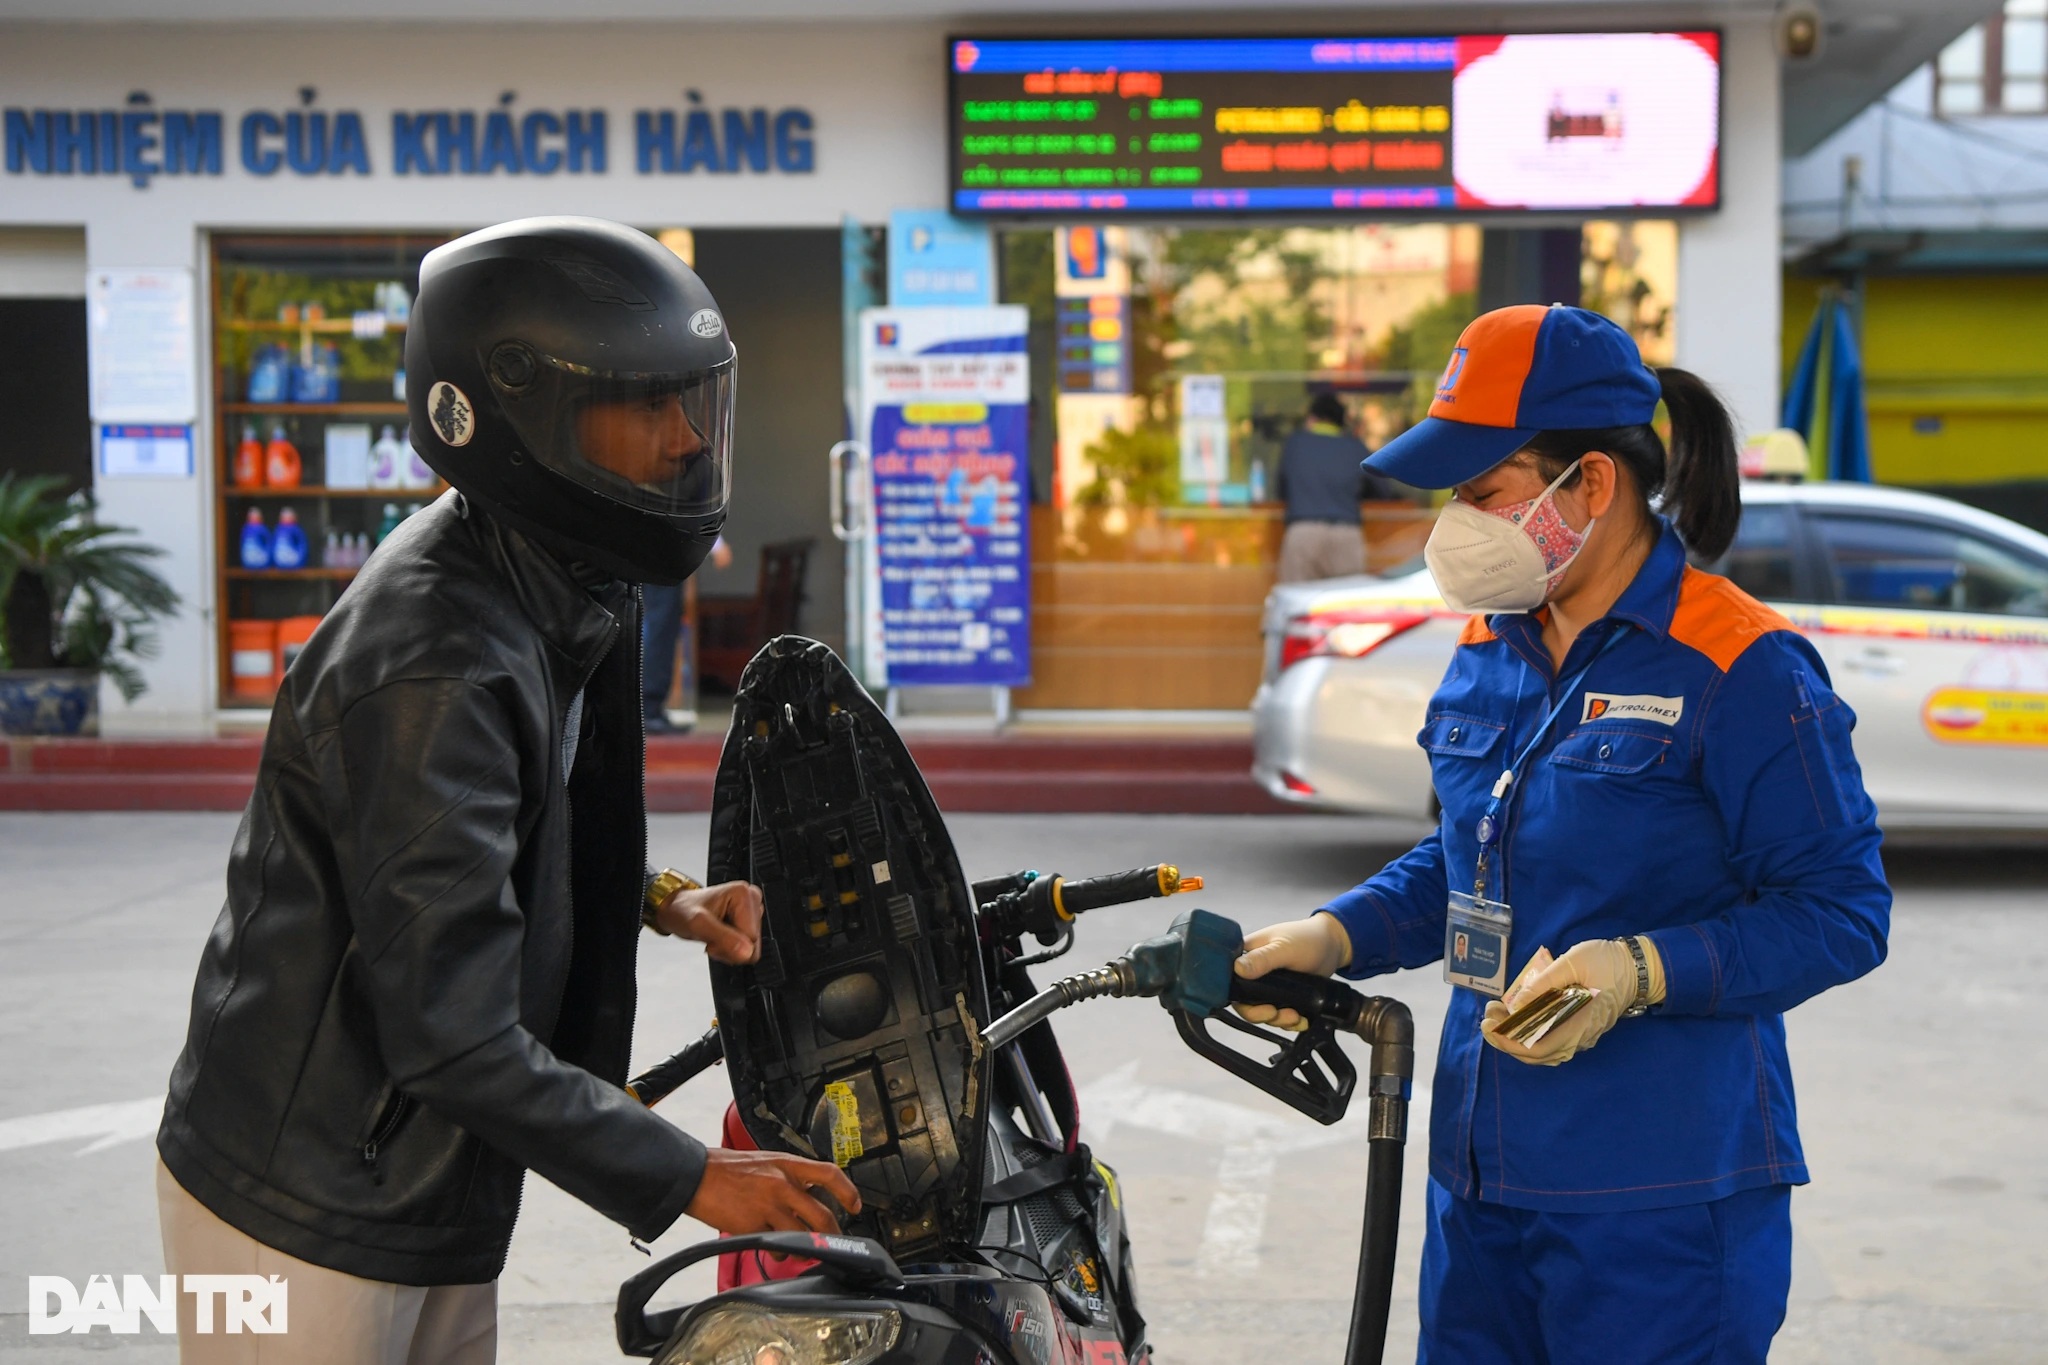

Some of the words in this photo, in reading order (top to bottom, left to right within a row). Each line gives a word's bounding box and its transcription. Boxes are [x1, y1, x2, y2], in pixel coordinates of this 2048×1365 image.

[4, 90, 224, 188] NHIỆM
[239, 87, 371, 178] CỦA
[391, 91, 607, 178] KHÁCH
[634, 89, 816, 176] HÀNG
[1607, 704, 1679, 719] PETROLIMEX
